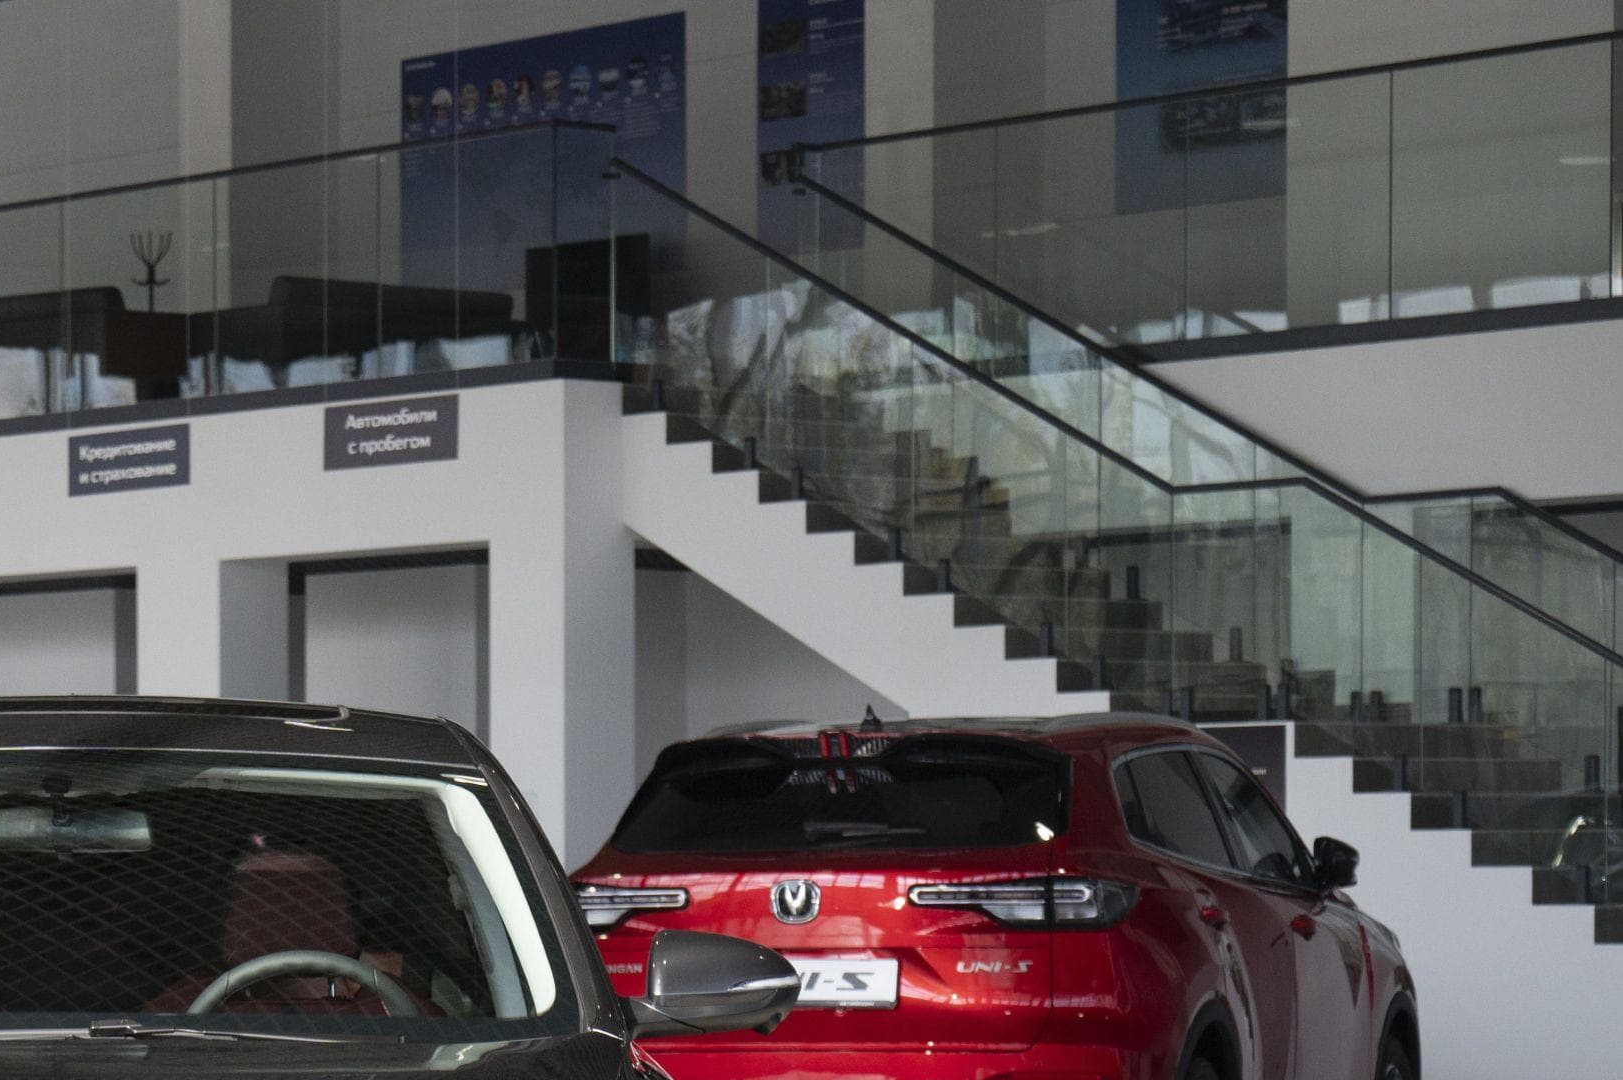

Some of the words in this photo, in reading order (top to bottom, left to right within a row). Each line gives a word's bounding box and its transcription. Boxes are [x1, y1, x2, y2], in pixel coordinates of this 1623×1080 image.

[345, 407, 437, 430] Автомобили
[79, 439, 176, 462] Кредитование
[347, 442, 357, 455] с
[359, 433, 431, 456] пробегом
[79, 472, 89, 484] и
[90, 463, 176, 485] страхование
[956, 961, 1033, 973] UNI-S
[800, 972, 875, 991] I-S
